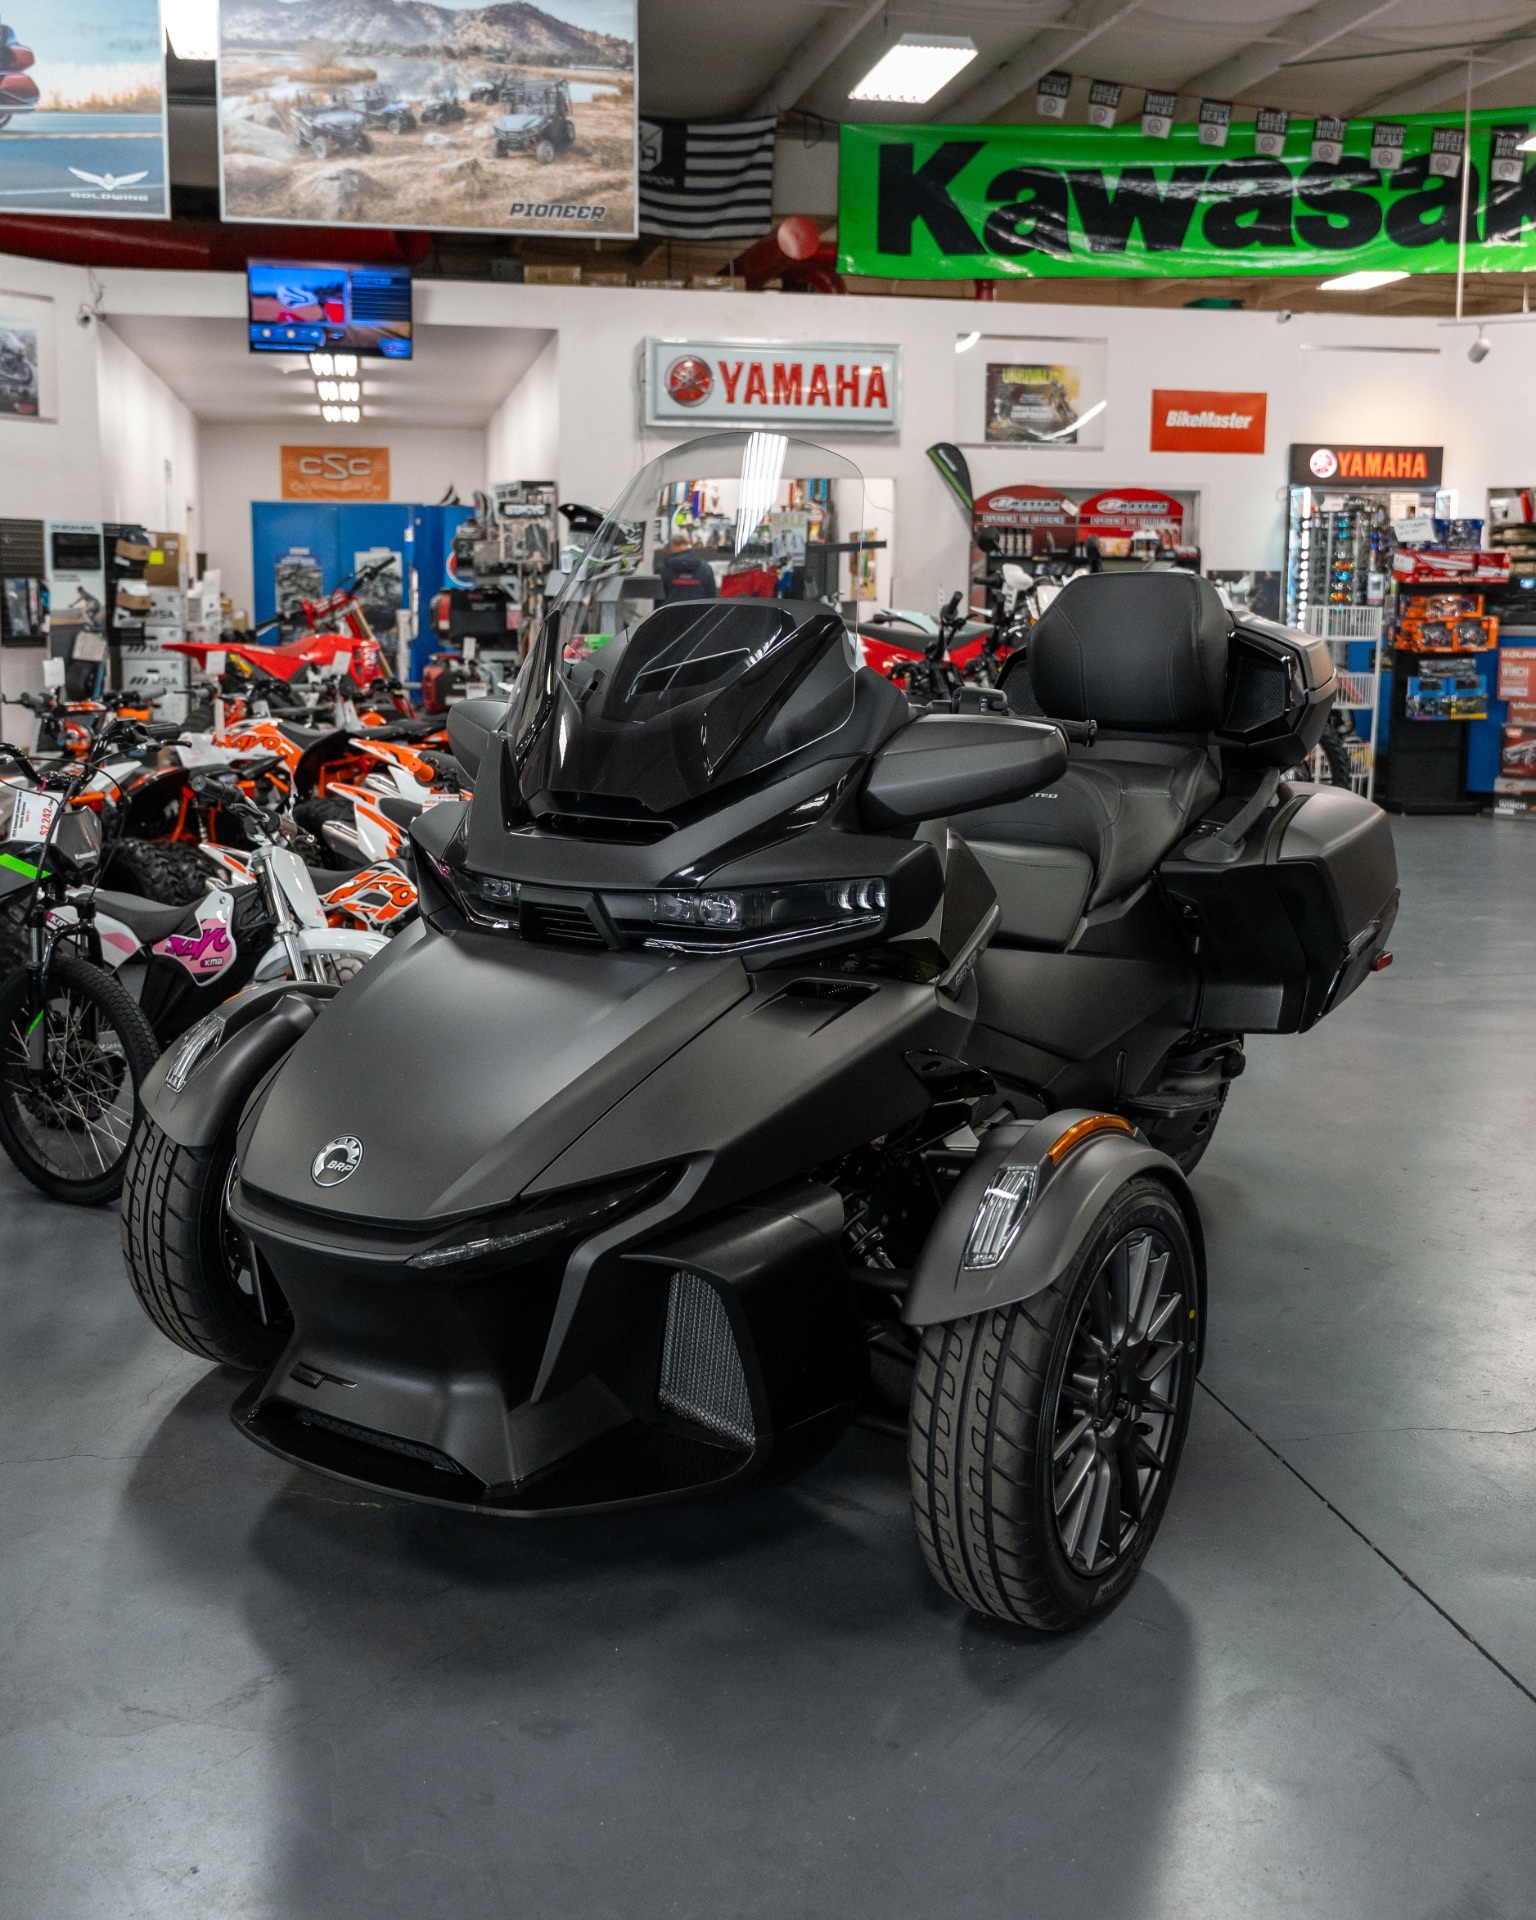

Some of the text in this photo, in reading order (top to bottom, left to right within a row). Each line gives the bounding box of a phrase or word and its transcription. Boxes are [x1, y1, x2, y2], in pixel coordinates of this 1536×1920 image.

[509, 203, 606, 220] PIONEER
[718, 361, 889, 409] YAMAHA
[1165, 410, 1253, 429] BikeMaster
[1337, 451, 1428, 479] YAMAHA
[326, 1160, 354, 1172] BRP
